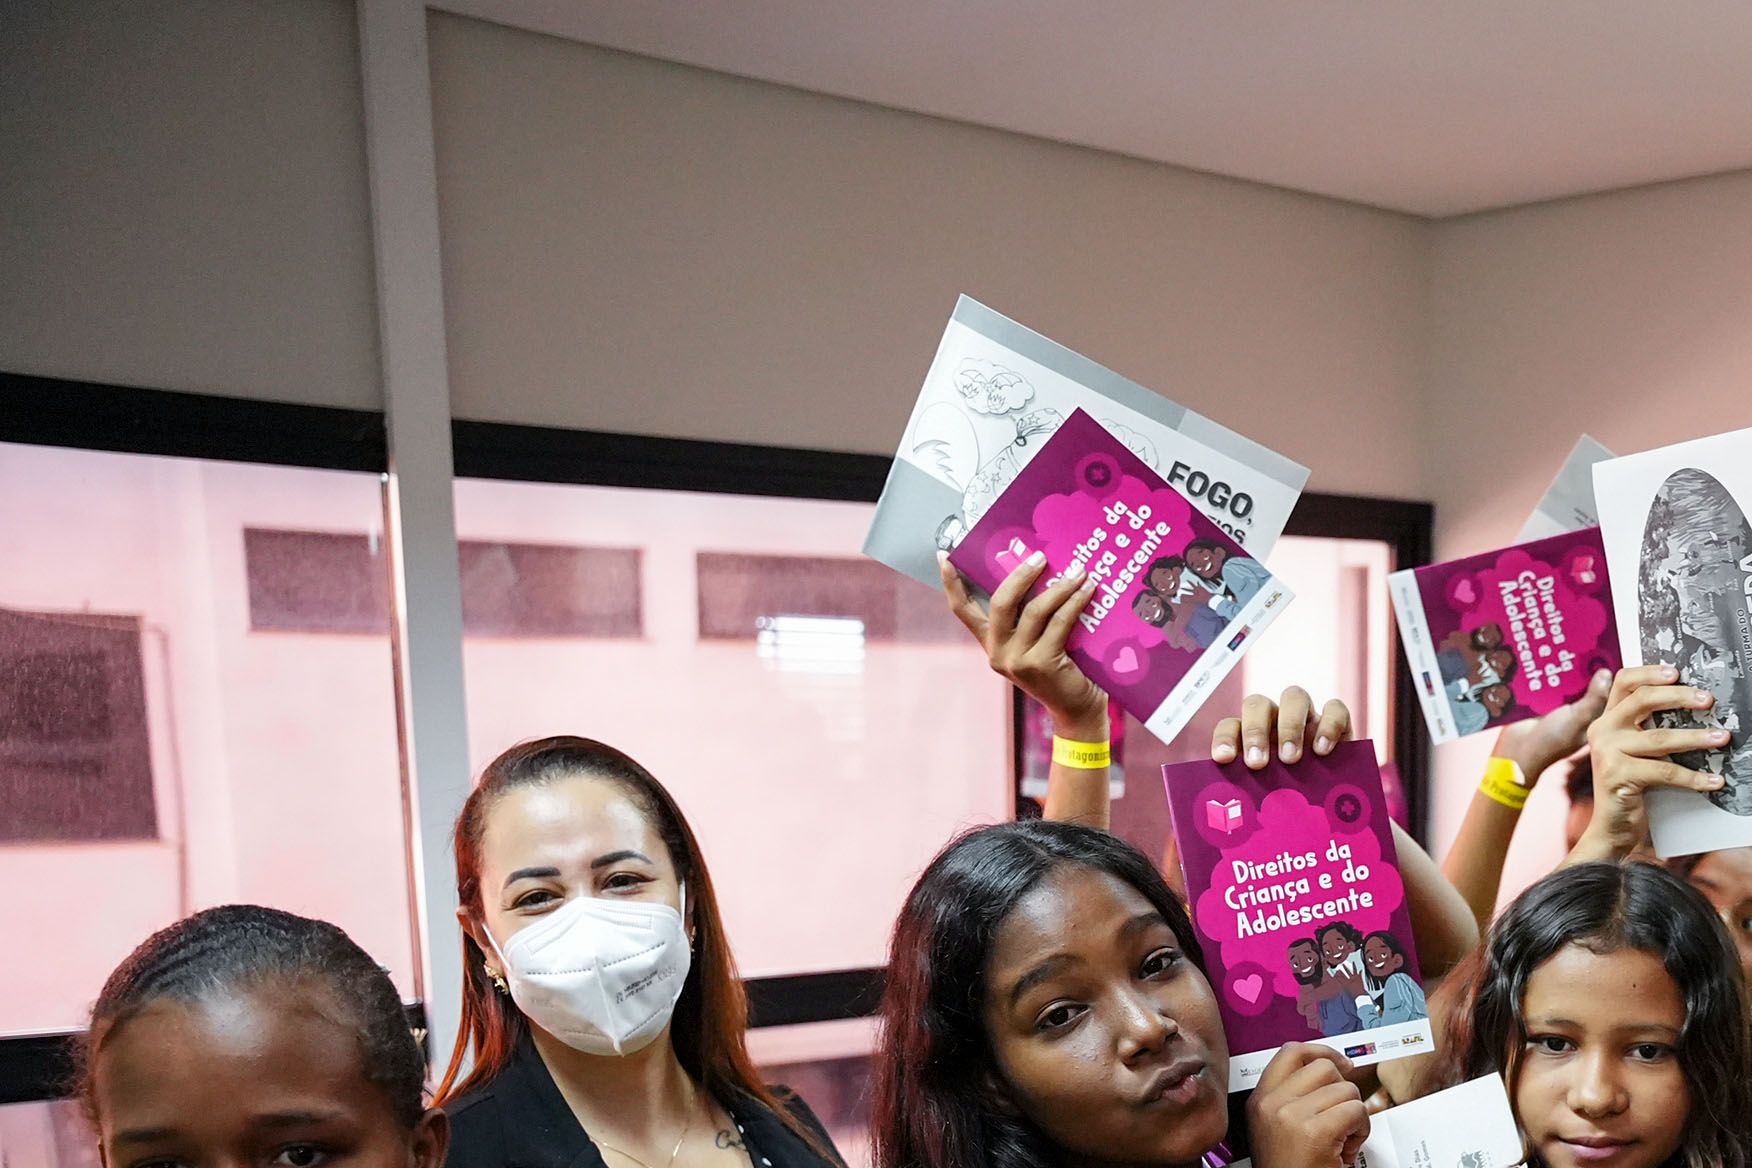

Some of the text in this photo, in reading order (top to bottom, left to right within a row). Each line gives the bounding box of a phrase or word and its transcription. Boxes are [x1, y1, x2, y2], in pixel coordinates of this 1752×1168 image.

[1103, 501, 1128, 525] da
[1166, 460, 1254, 526] FOGO,
[1115, 504, 1152, 548] e do
[1079, 521, 1171, 634] Adolescente
[1498, 580, 1543, 692] Adolescente
[1518, 570, 1562, 687] Criança e do
[1536, 575, 1576, 672] Direitos da
[1224, 859, 1370, 910] Criança e do
[1232, 839, 1352, 884] Direitos da
[1236, 888, 1374, 939] Adolescente
